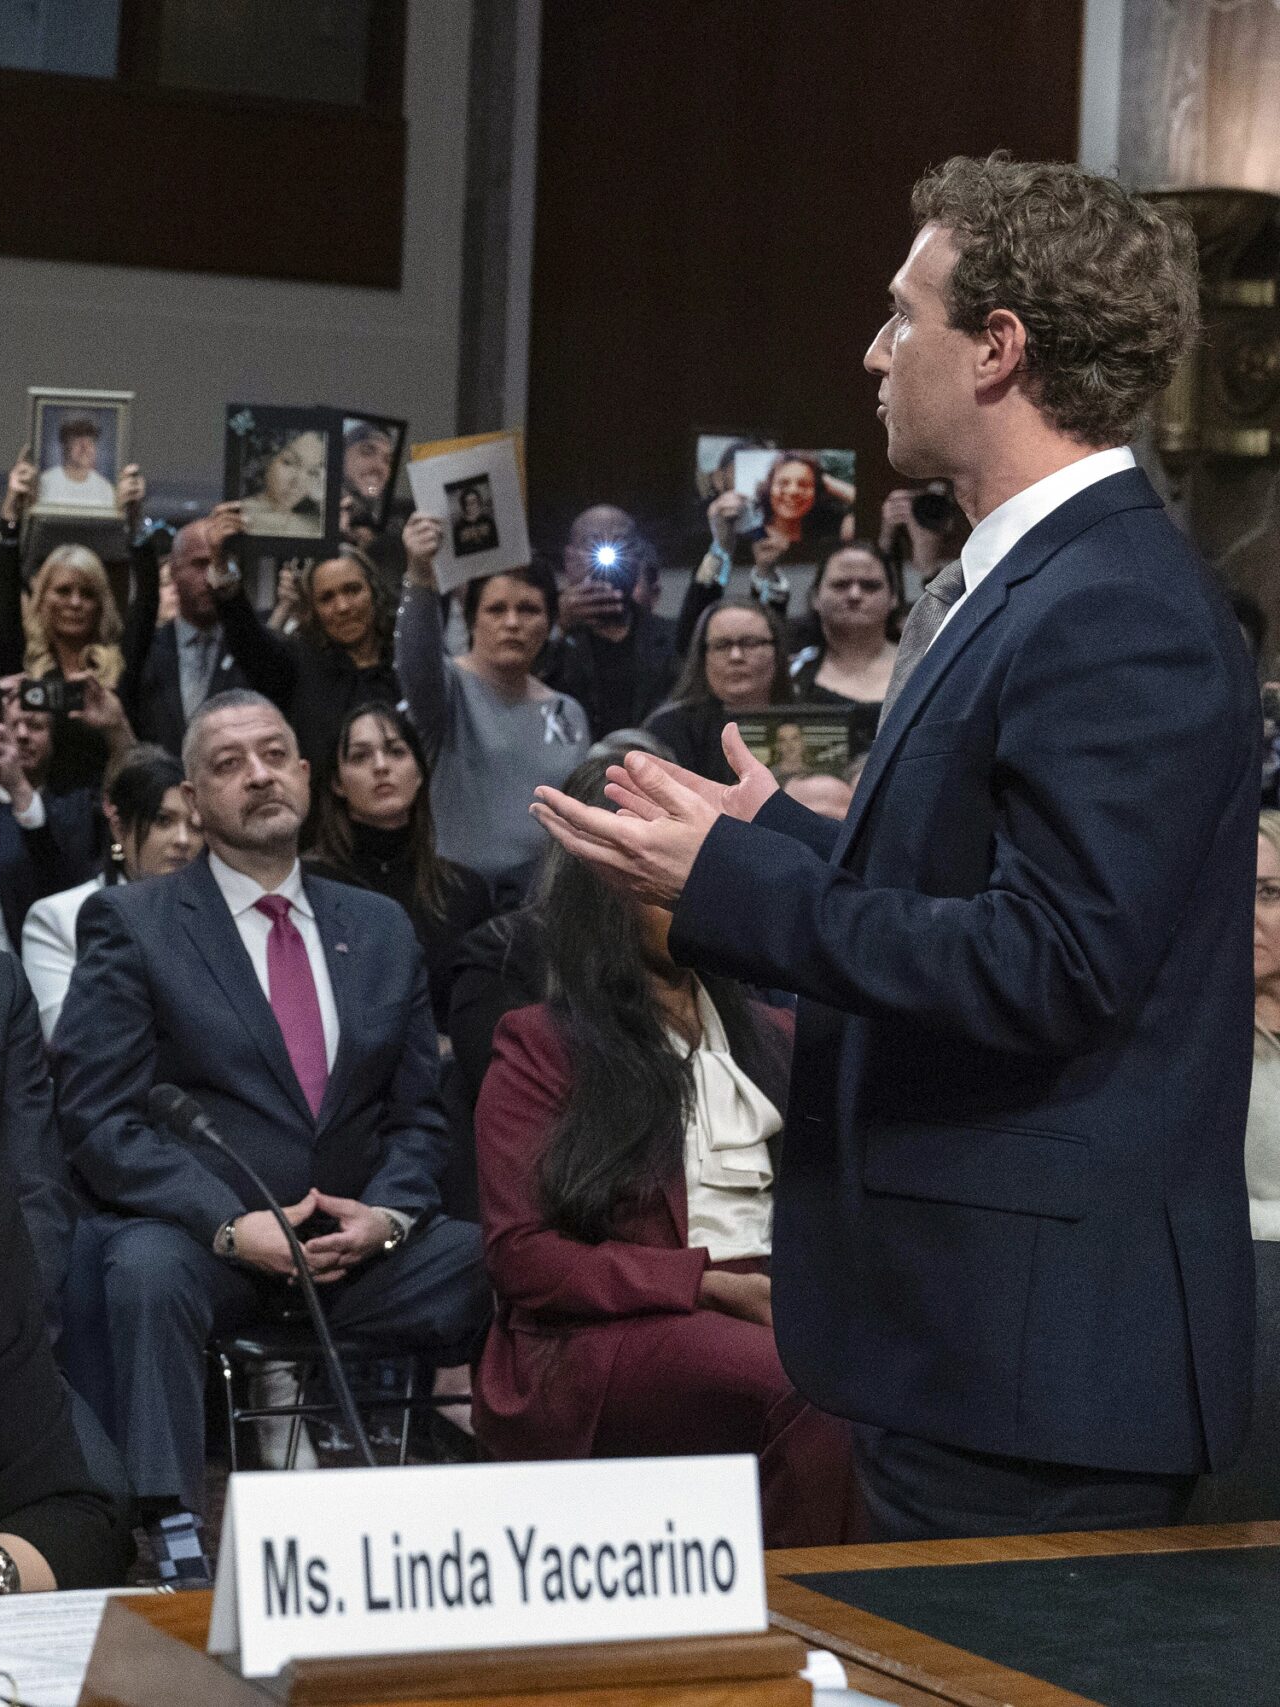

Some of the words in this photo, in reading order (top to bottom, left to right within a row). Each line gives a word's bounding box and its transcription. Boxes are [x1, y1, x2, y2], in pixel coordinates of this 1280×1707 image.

[262, 1537, 345, 1618] Ms.
[362, 1530, 493, 1613] Linda
[506, 1519, 736, 1605] Yaccarino
